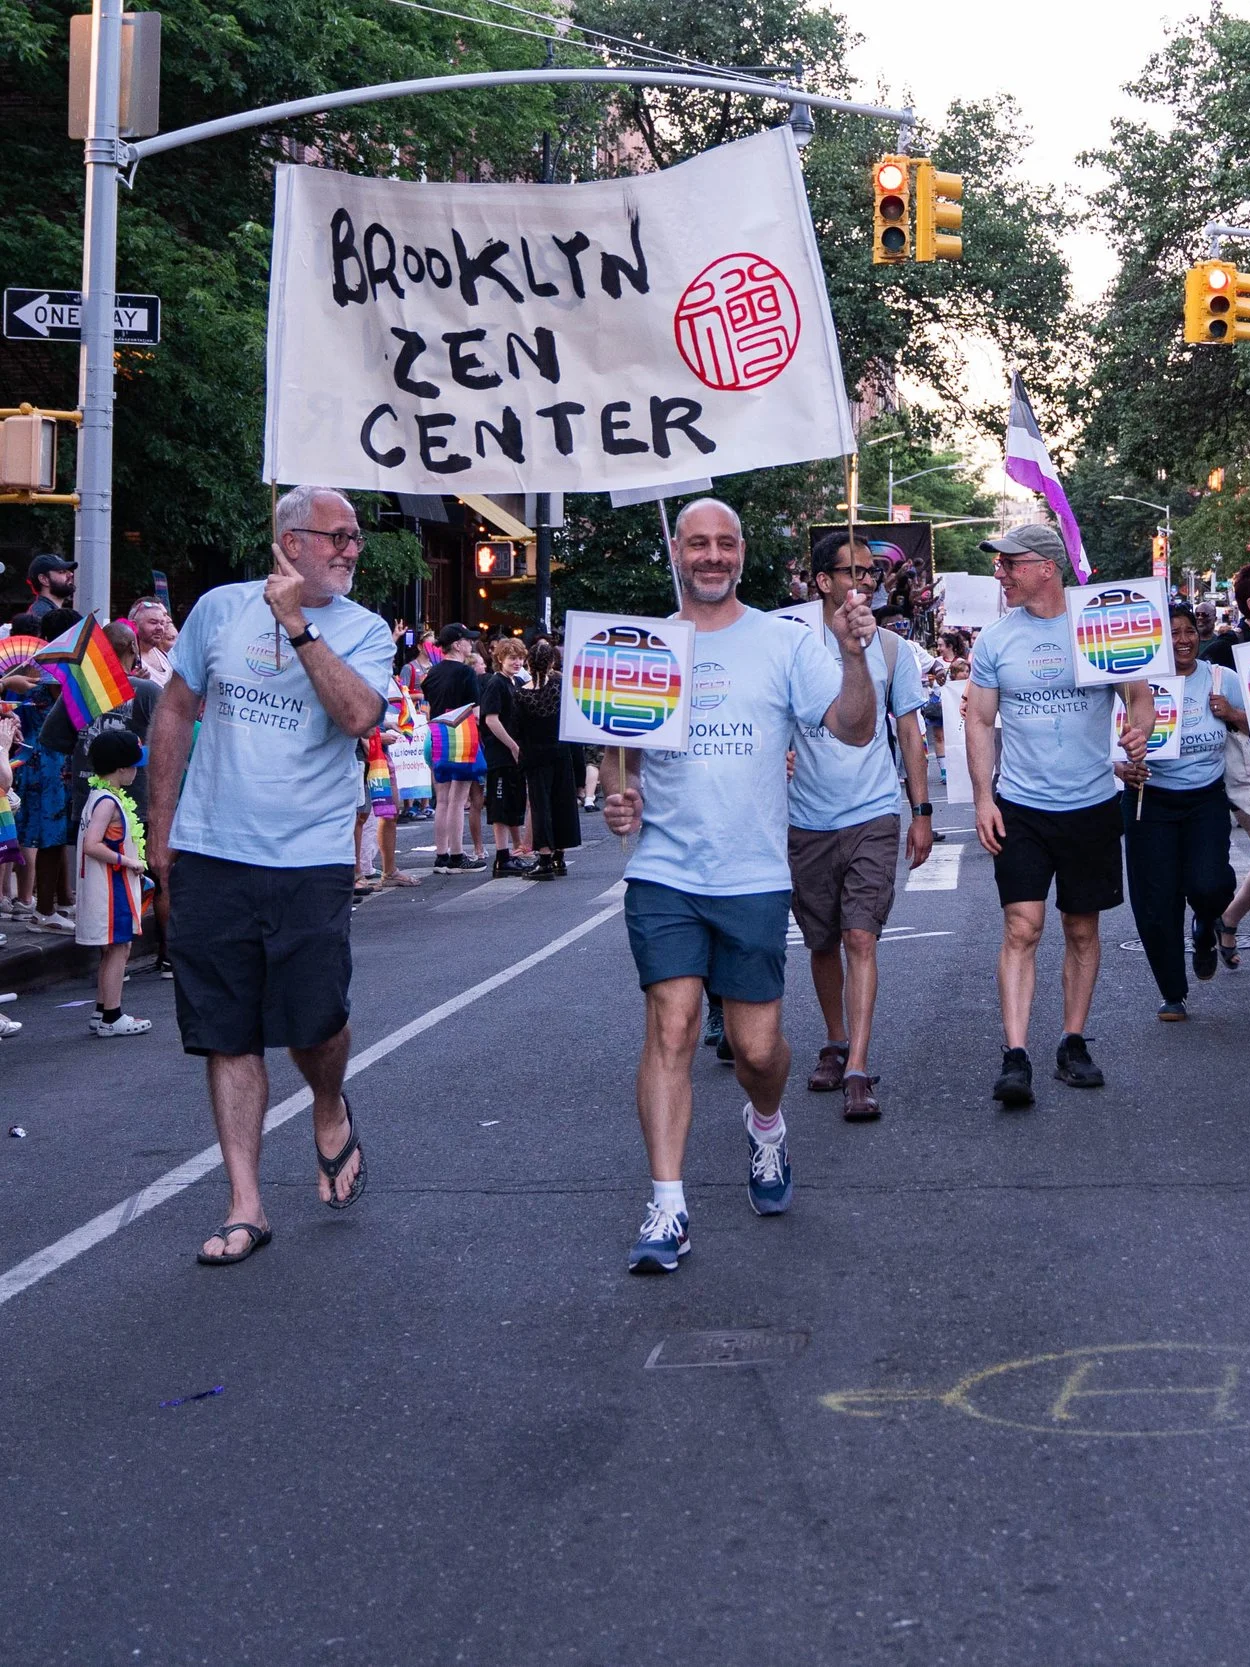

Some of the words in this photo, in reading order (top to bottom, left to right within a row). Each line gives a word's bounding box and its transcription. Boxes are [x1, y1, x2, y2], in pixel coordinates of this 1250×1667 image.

[331, 205, 649, 307] BROOKLYN
[34, 306, 79, 325] ONE
[114, 309, 138, 328] AY
[390, 326, 560, 399] ZEN
[360, 395, 717, 475] CENTER
[218, 682, 304, 714] BROOKLYN
[1015, 687, 1086, 702] BROOKLYN
[218, 701, 235, 717] ZEN
[239, 707, 299, 732] CENTER
[1017, 705, 1039, 715] ZEN
[1042, 701, 1089, 715] CENTER
[689, 723, 753, 737] OKLYN
[803, 726, 825, 738] ZEN
[1180, 730, 1224, 746] OKLYN
[693, 742, 753, 756] CENTER
